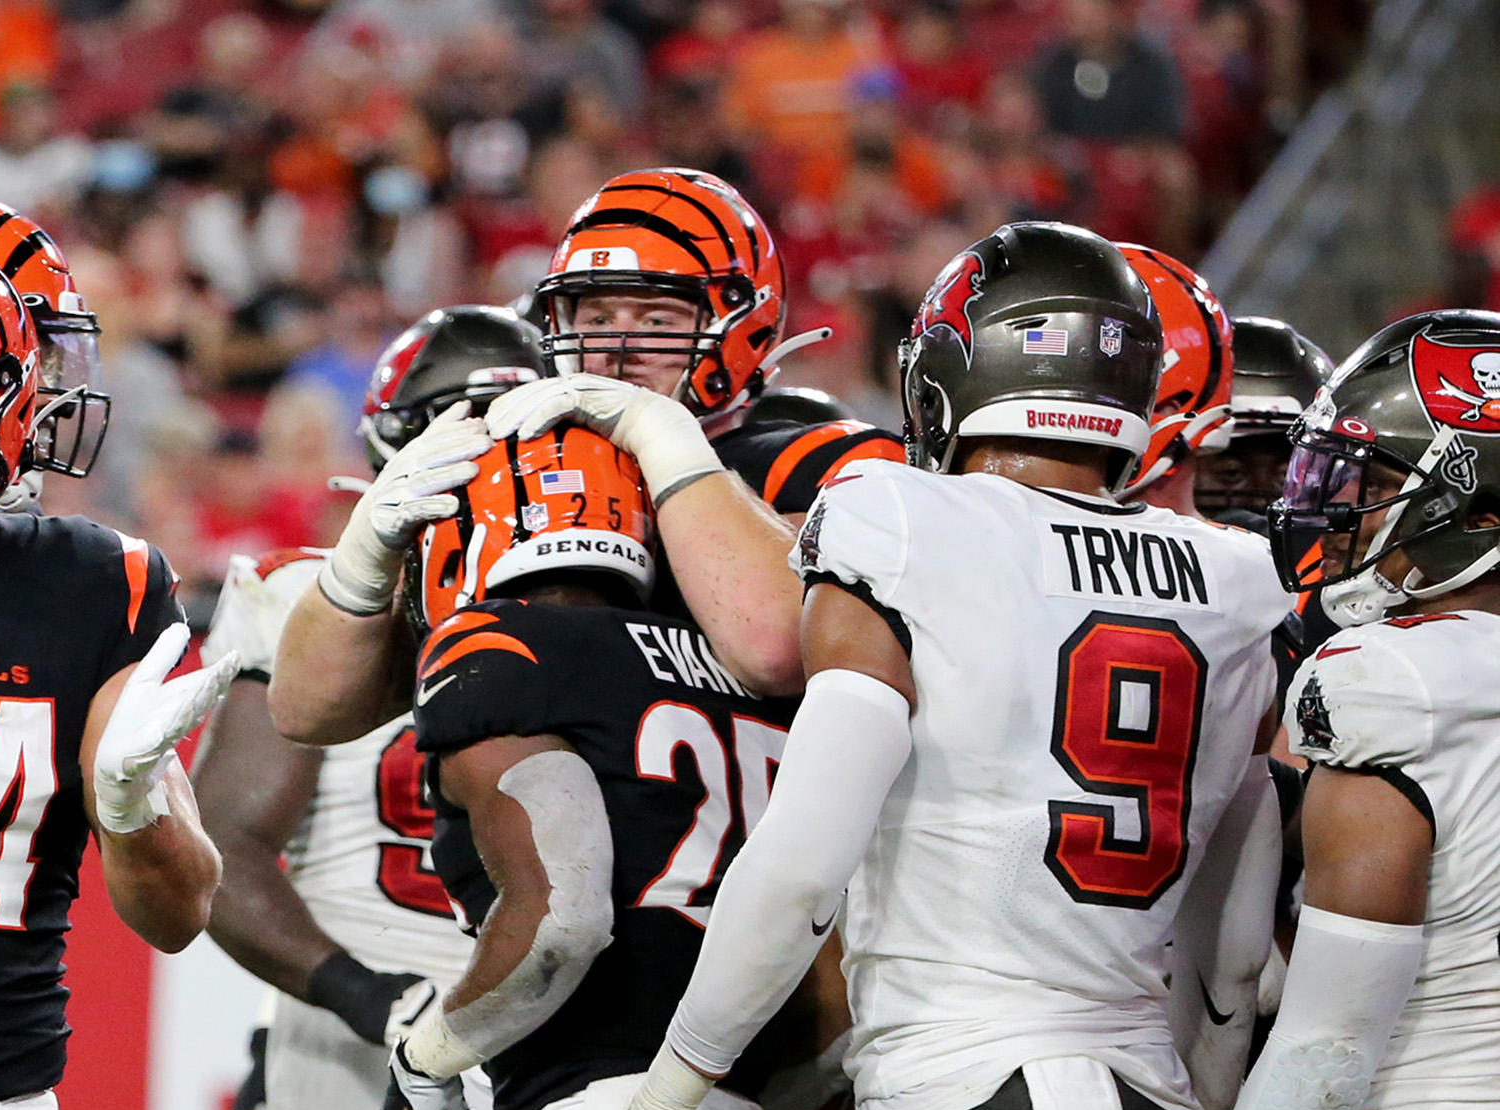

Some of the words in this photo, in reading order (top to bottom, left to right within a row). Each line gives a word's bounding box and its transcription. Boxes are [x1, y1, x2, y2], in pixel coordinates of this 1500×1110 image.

[1102, 337, 1118, 352] NFL
[1026, 409, 1123, 437] BUCCANEERS
[536, 540, 646, 568] BENGALS
[1050, 523, 1209, 605] TRYON
[1043, 610, 1209, 910] 9
